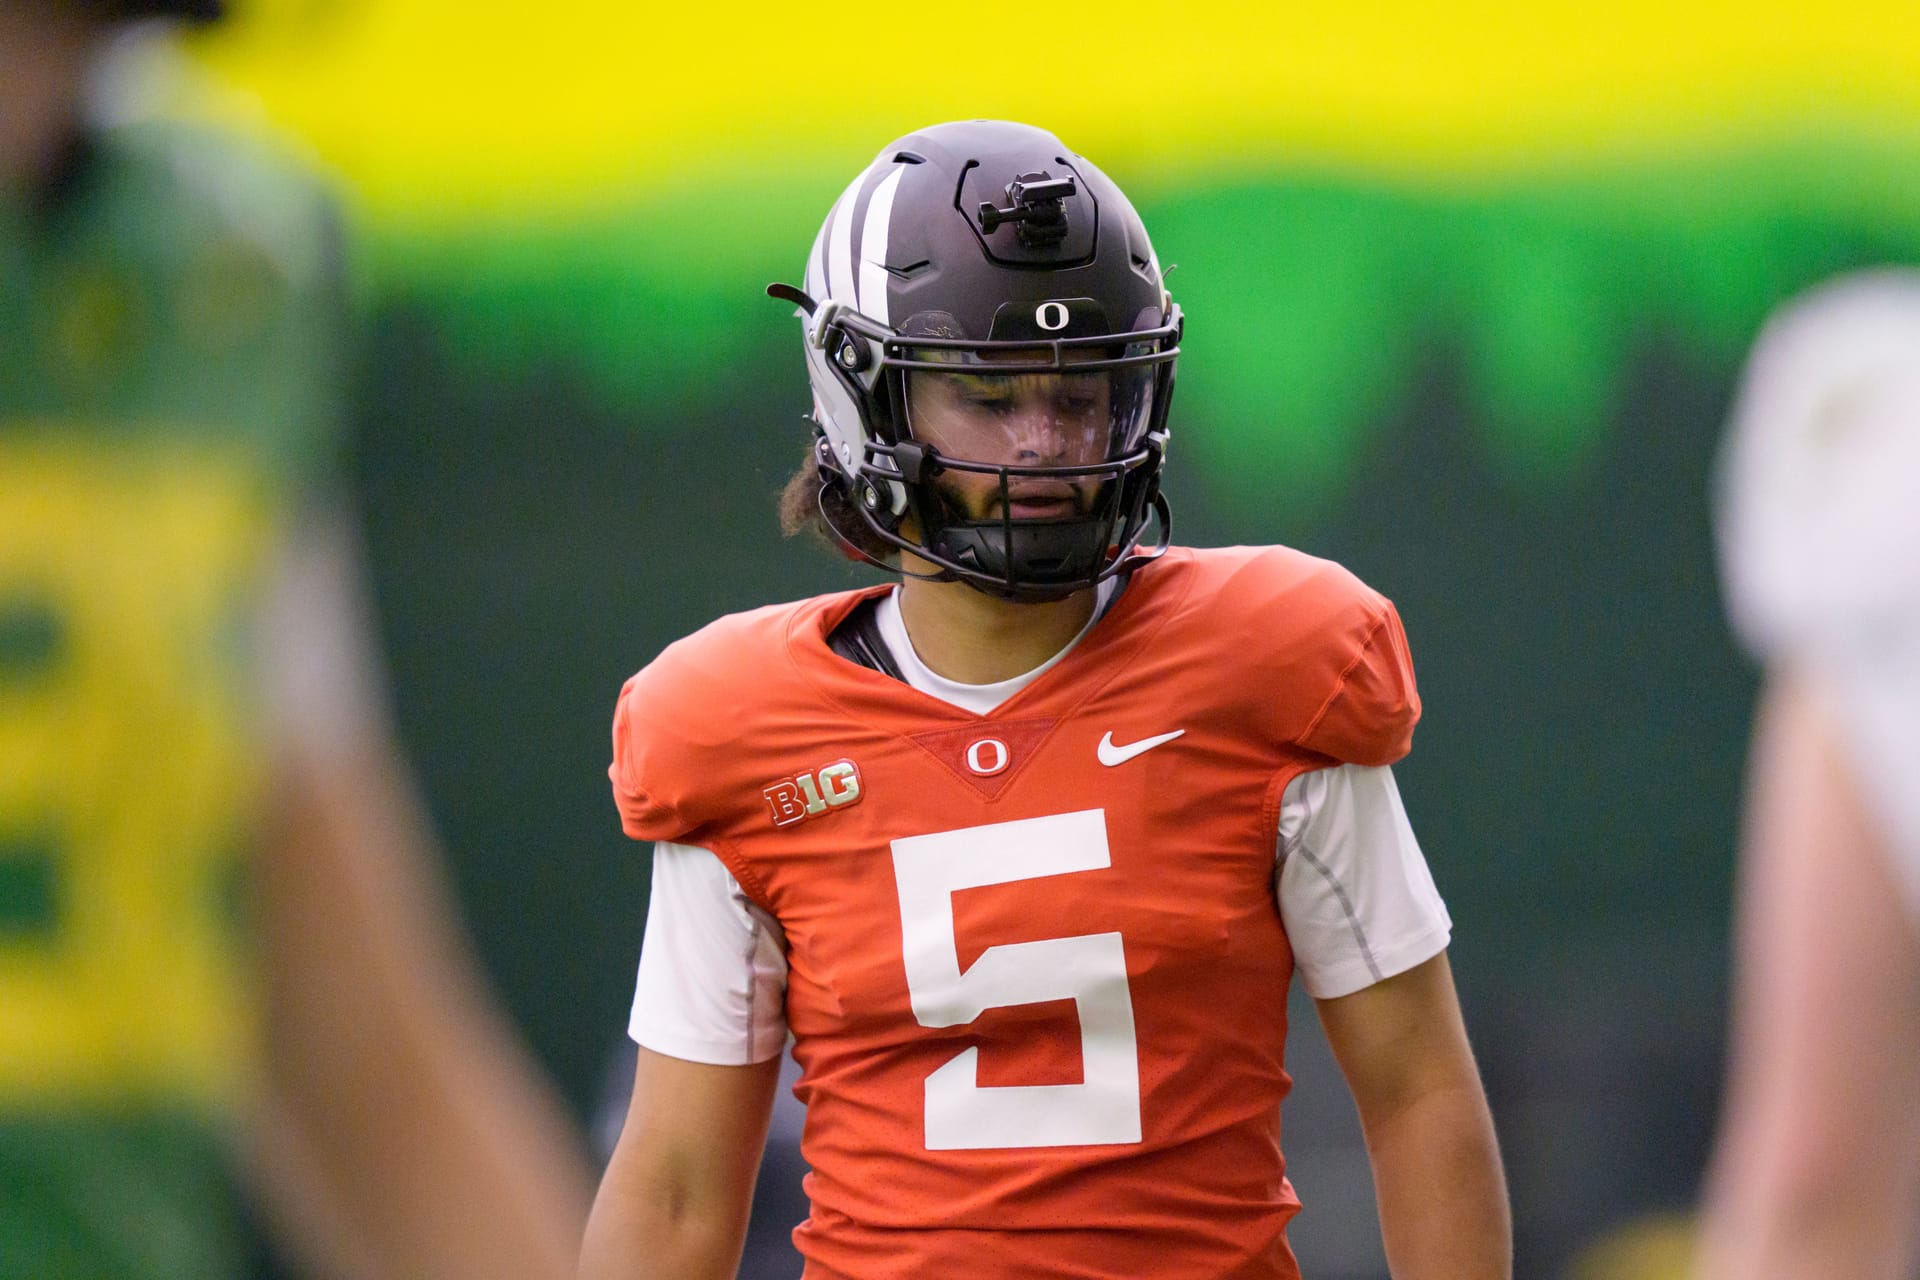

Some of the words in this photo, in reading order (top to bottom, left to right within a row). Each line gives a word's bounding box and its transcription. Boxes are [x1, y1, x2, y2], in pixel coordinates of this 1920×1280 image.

[1035, 302, 1070, 331] O
[966, 739, 1008, 773] O
[890, 807, 1143, 1150] 5
